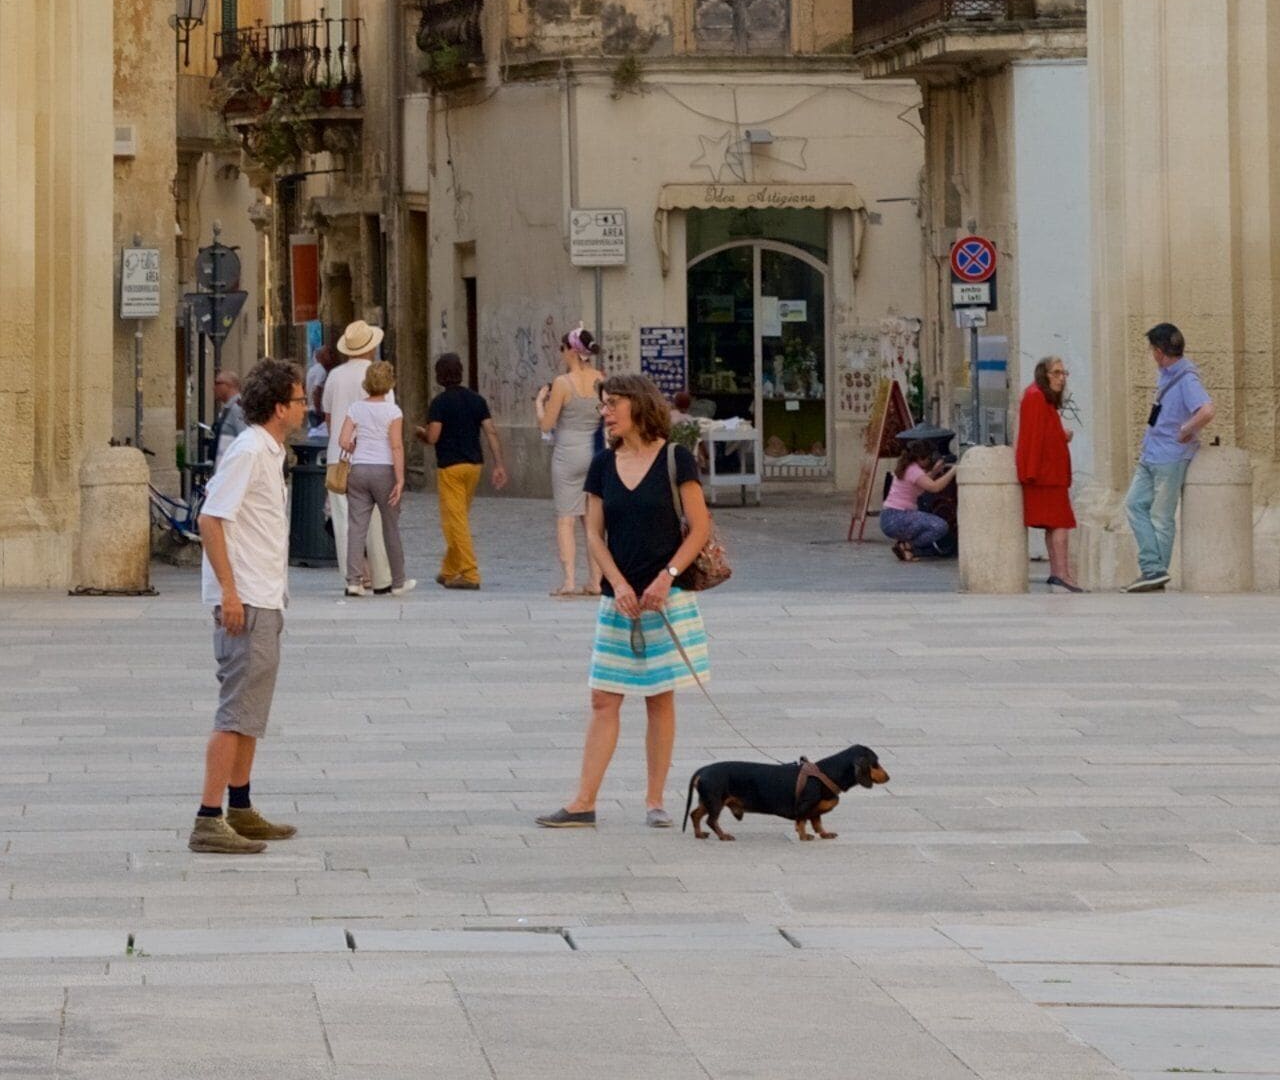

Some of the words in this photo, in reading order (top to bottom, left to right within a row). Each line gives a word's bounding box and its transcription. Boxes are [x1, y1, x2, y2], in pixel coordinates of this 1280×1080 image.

[705, 185, 735, 203] Idea
[746, 187, 816, 207] Artigiana
[602, 228, 623, 237] AREA
